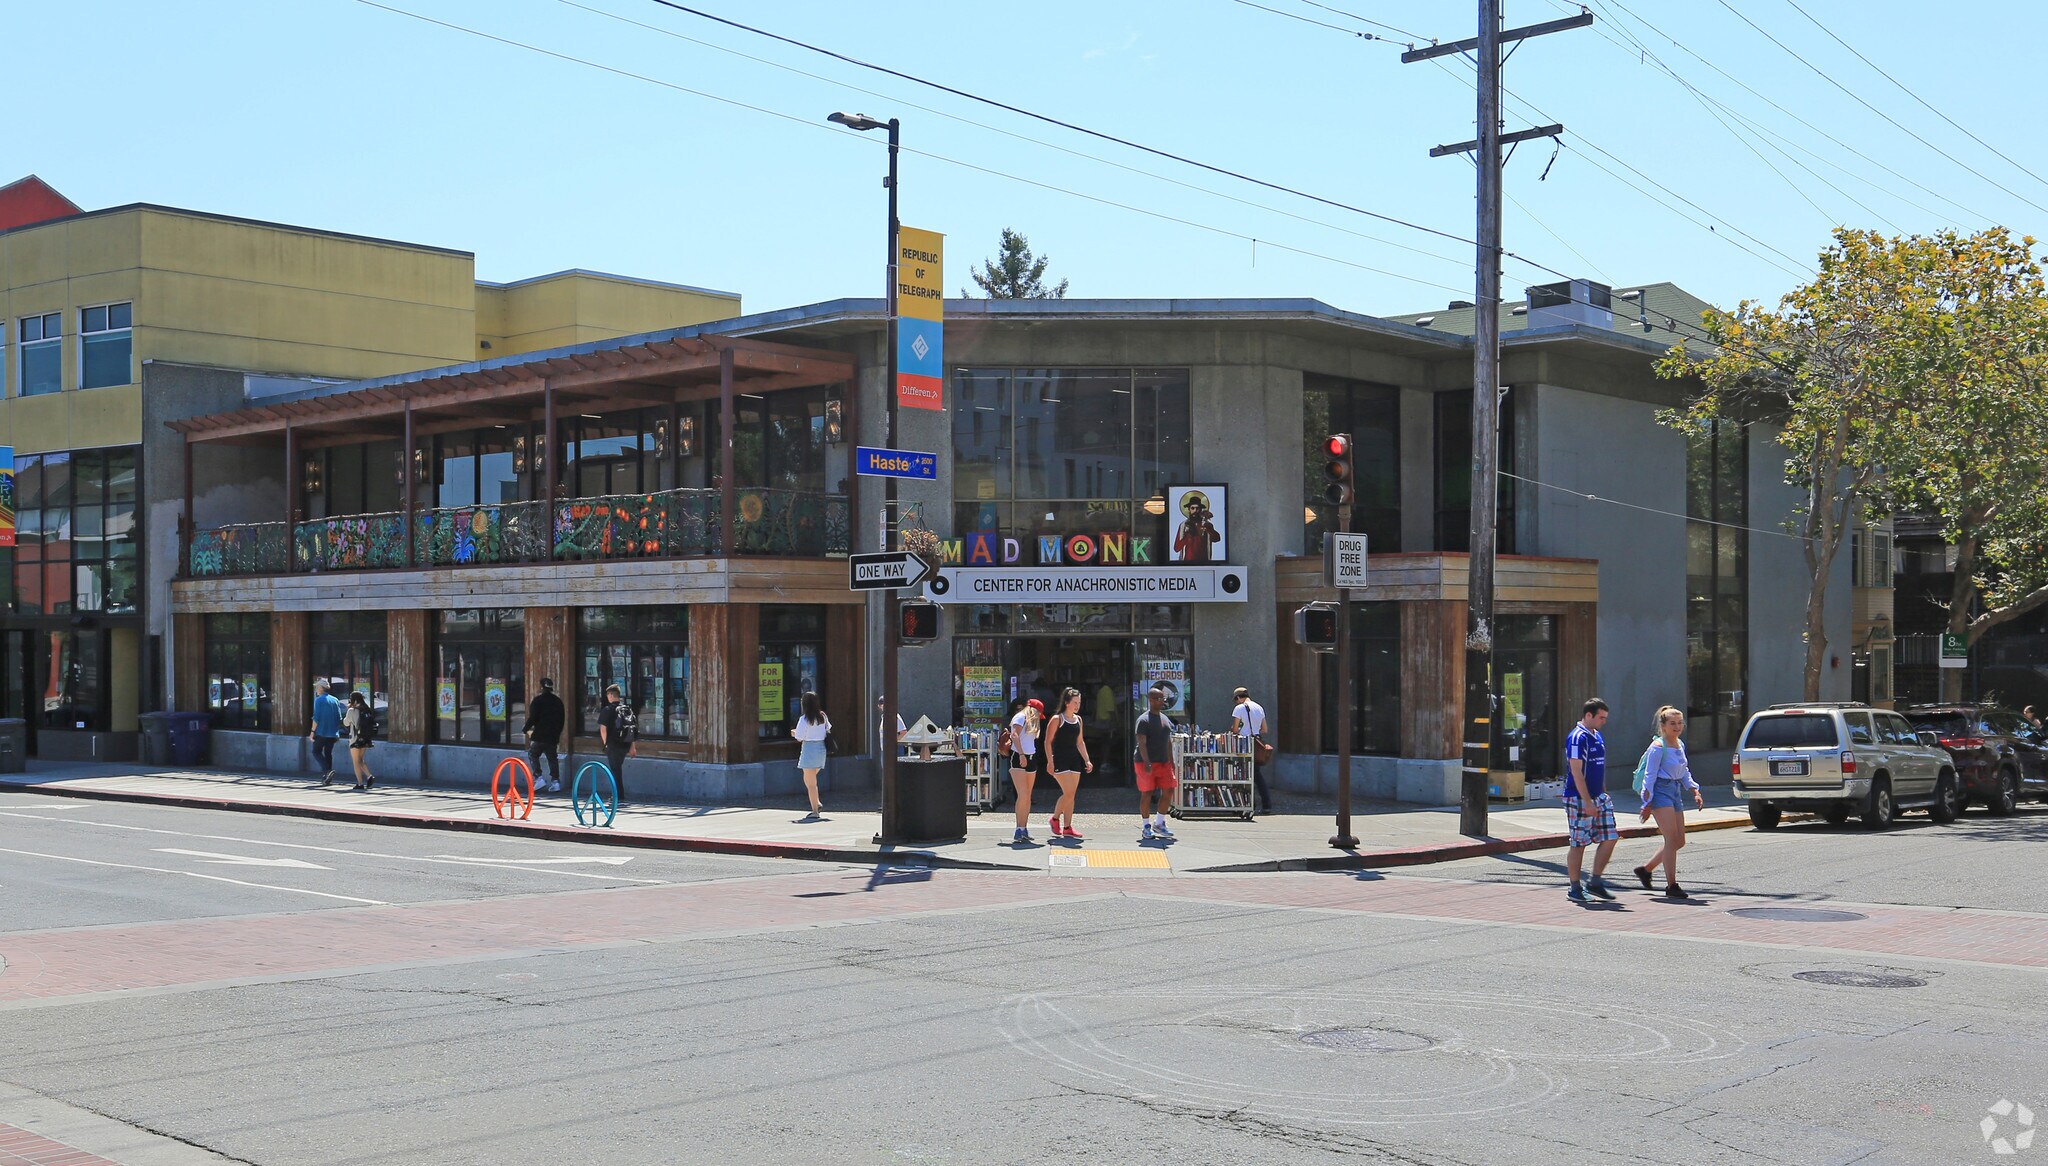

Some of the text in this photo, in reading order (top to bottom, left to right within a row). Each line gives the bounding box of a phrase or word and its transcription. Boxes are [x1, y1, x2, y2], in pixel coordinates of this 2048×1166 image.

[902, 248, 938, 264] REPUBLIC
[915, 268, 926, 279] OF
[898, 284, 941, 300] TELEGRAPH
[870, 453, 909, 471] Haste
[943, 534, 1150, 563] MAD MONK
[1339, 540, 1361, 551] DRUG
[1340, 553, 1360, 563] FREE
[859, 563, 905, 579] ONE WAY
[1340, 565, 1361, 576] ZONE
[974, 578, 1197, 592] CENTER FOR ANACHRONISTIC MEDIA
[1949, 637, 1956, 647] 8
[1146, 662, 1180, 670] WE BUY
[762, 668, 777, 676] FOR
[1145, 671, 1183, 680] RECORDS
